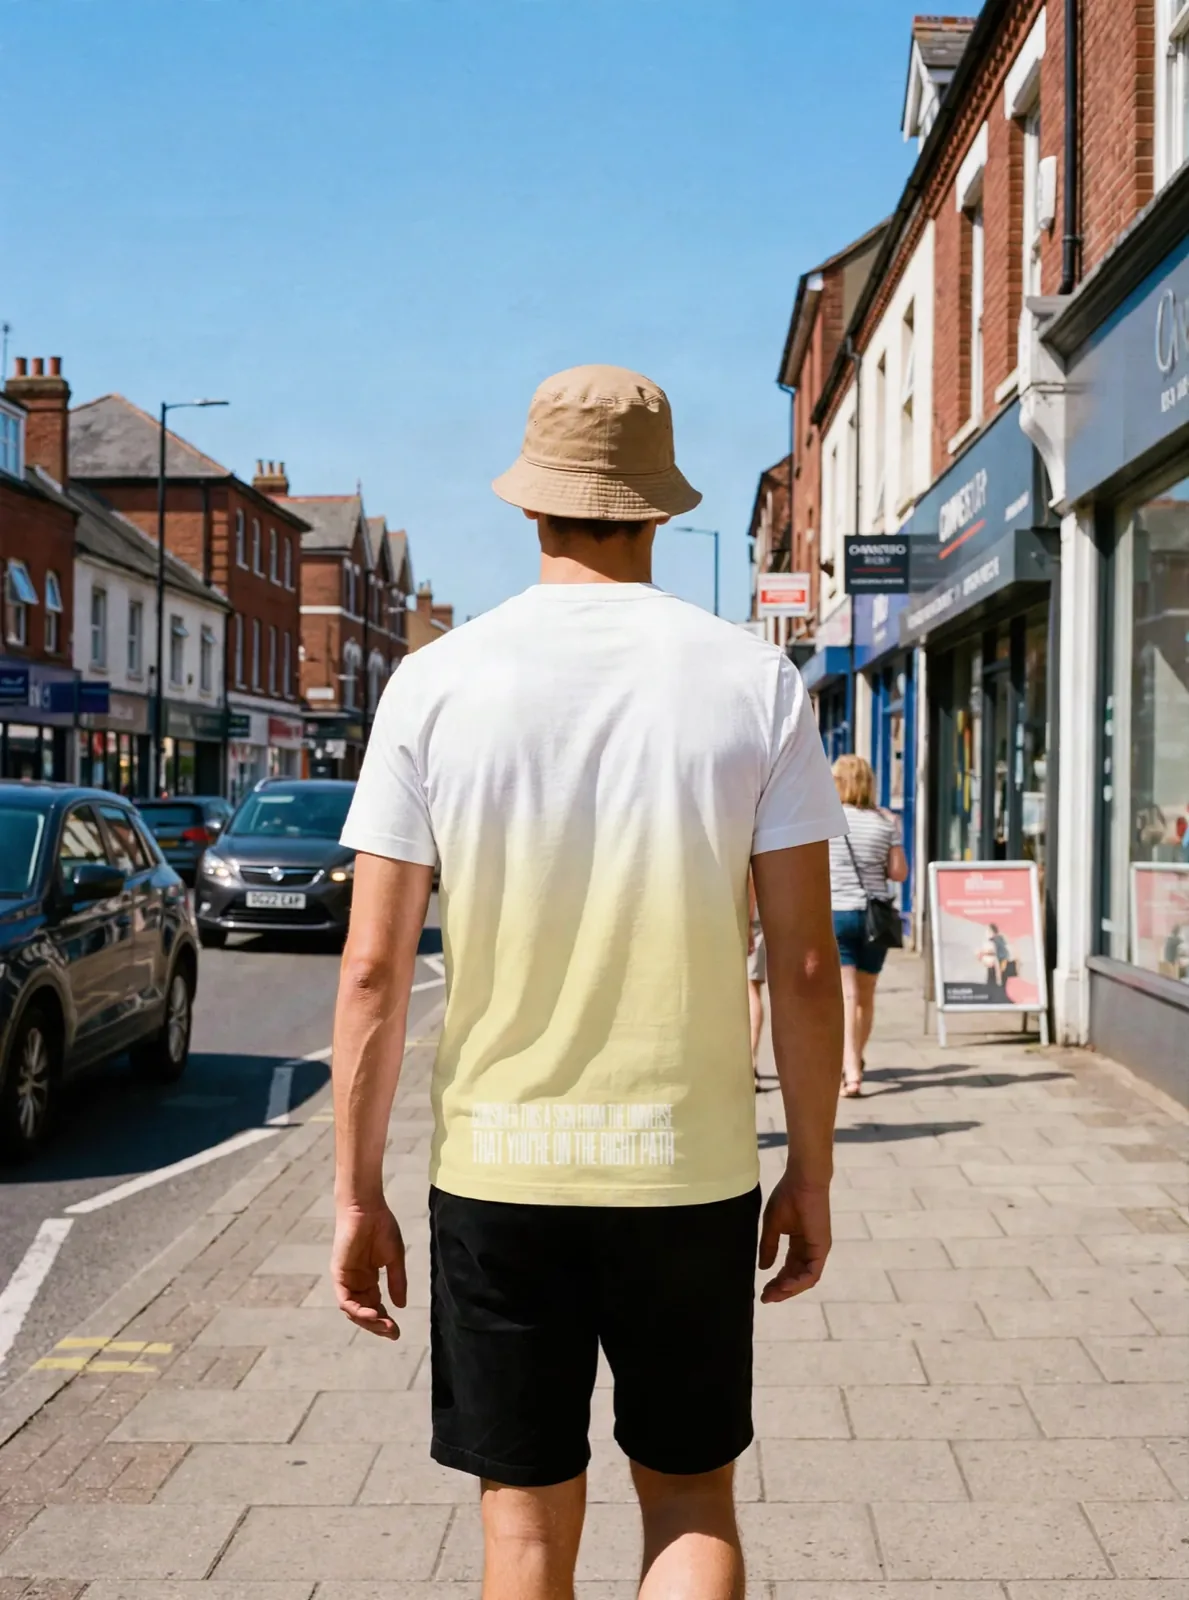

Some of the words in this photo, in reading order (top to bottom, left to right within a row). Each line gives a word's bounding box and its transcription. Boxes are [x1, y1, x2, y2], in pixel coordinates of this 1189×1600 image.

[472, 1131, 503, 1164] THAT
[552, 1131, 571, 1165] ON
[573, 1131, 597, 1165] THE
[600, 1131, 638, 1165] RIGHT
[639, 1131, 674, 1165] PATH
